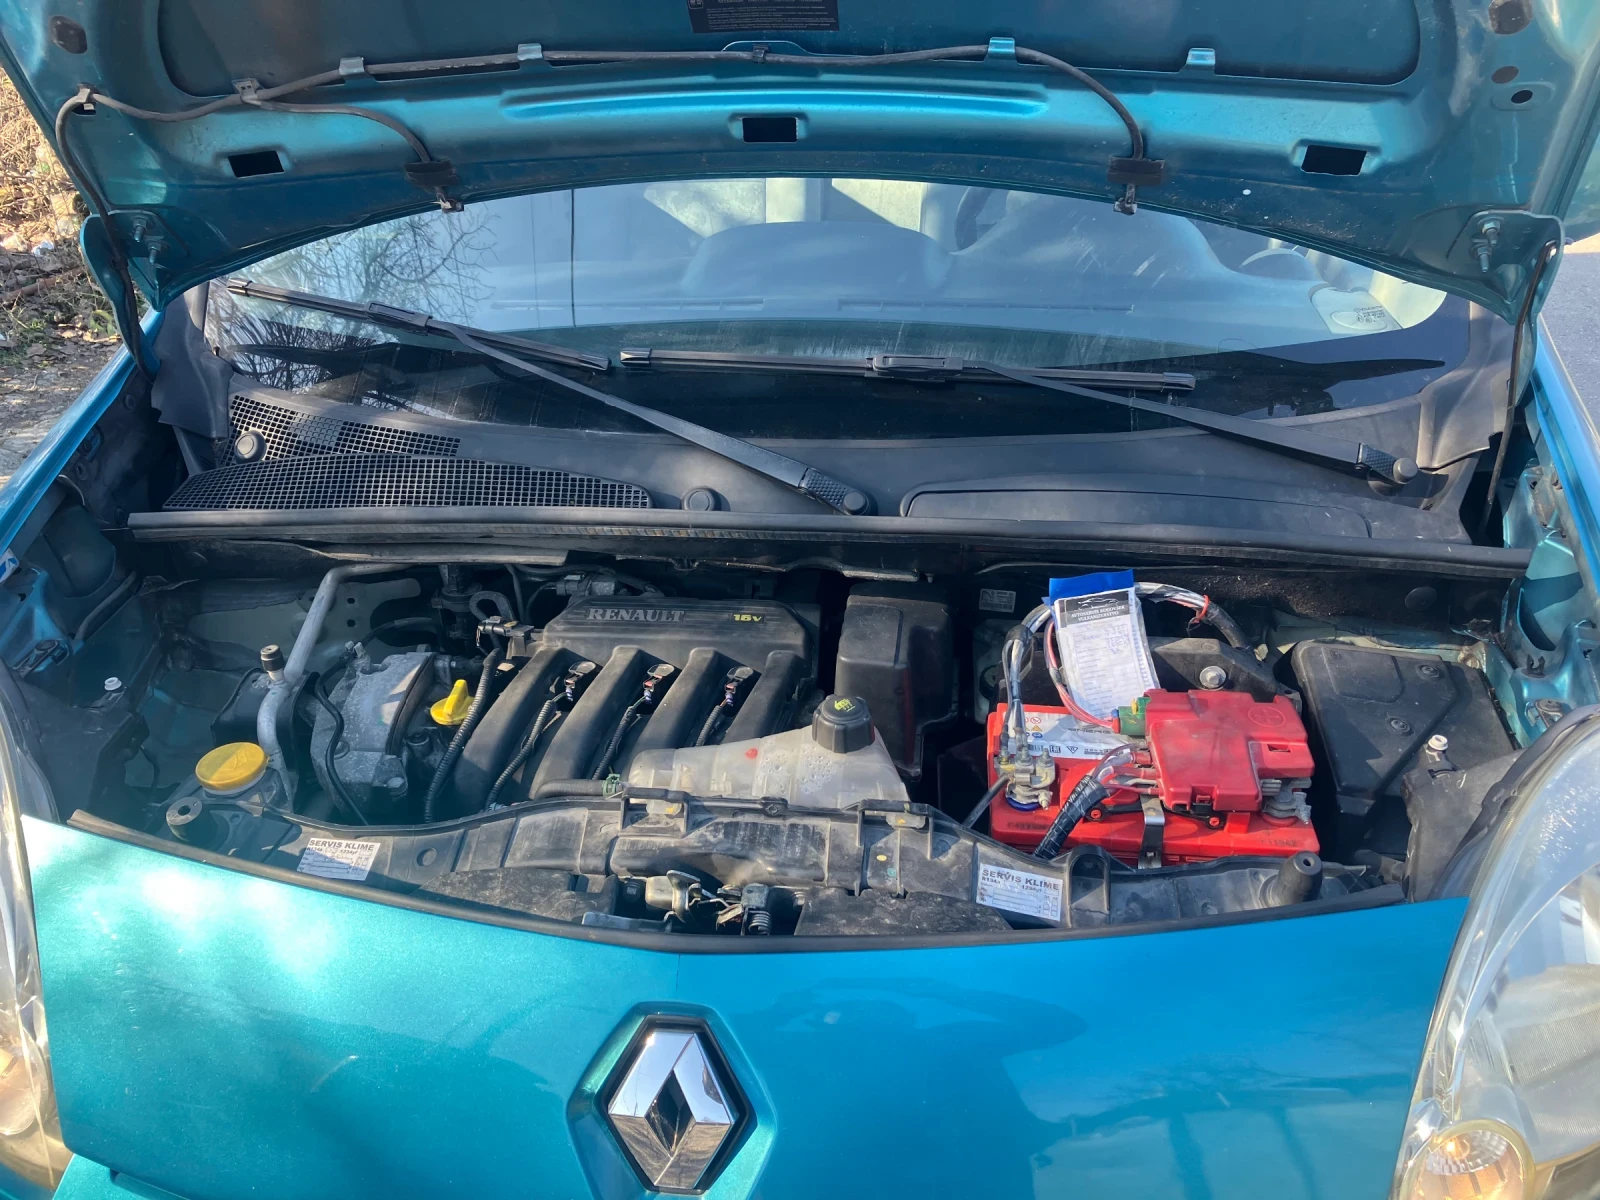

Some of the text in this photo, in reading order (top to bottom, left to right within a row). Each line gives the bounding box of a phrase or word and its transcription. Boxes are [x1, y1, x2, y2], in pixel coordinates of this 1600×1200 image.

[587, 608, 684, 621] RENAULT
[309, 840, 342, 848] SERVIS
[983, 869, 1059, 890] SERVIS KLIME
